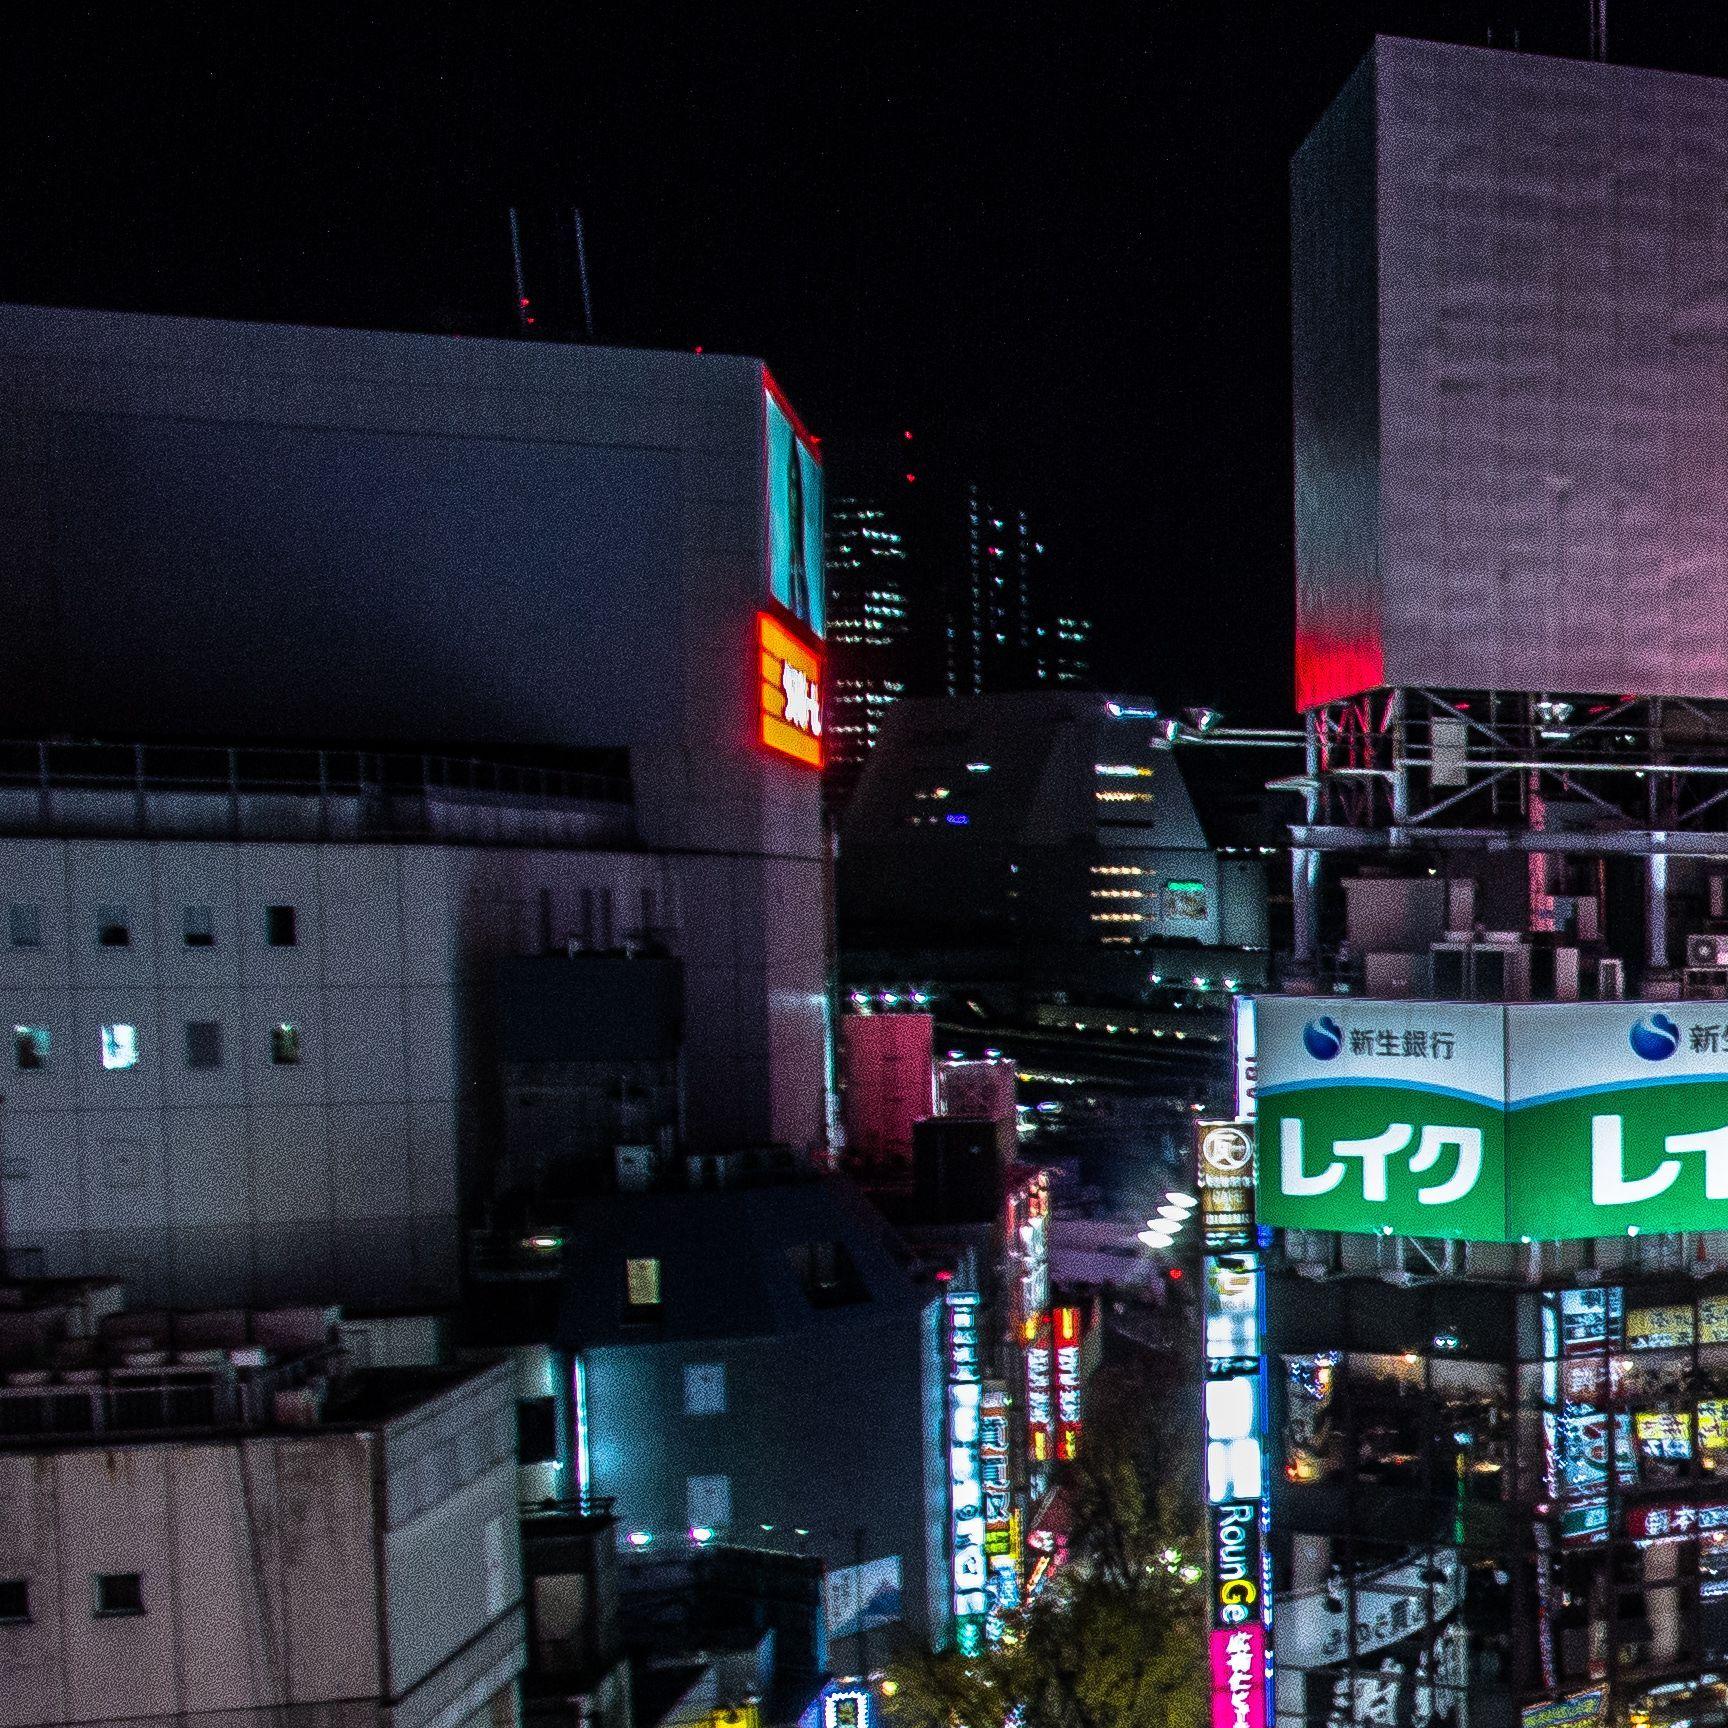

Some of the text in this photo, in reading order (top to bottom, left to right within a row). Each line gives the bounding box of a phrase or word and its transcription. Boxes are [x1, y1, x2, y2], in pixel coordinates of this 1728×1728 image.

[1350, 1027, 1455, 1061] 新生銀行
[1281, 1117, 1481, 1204] レイク
[1219, 1505, 1255, 1622] RounGe
